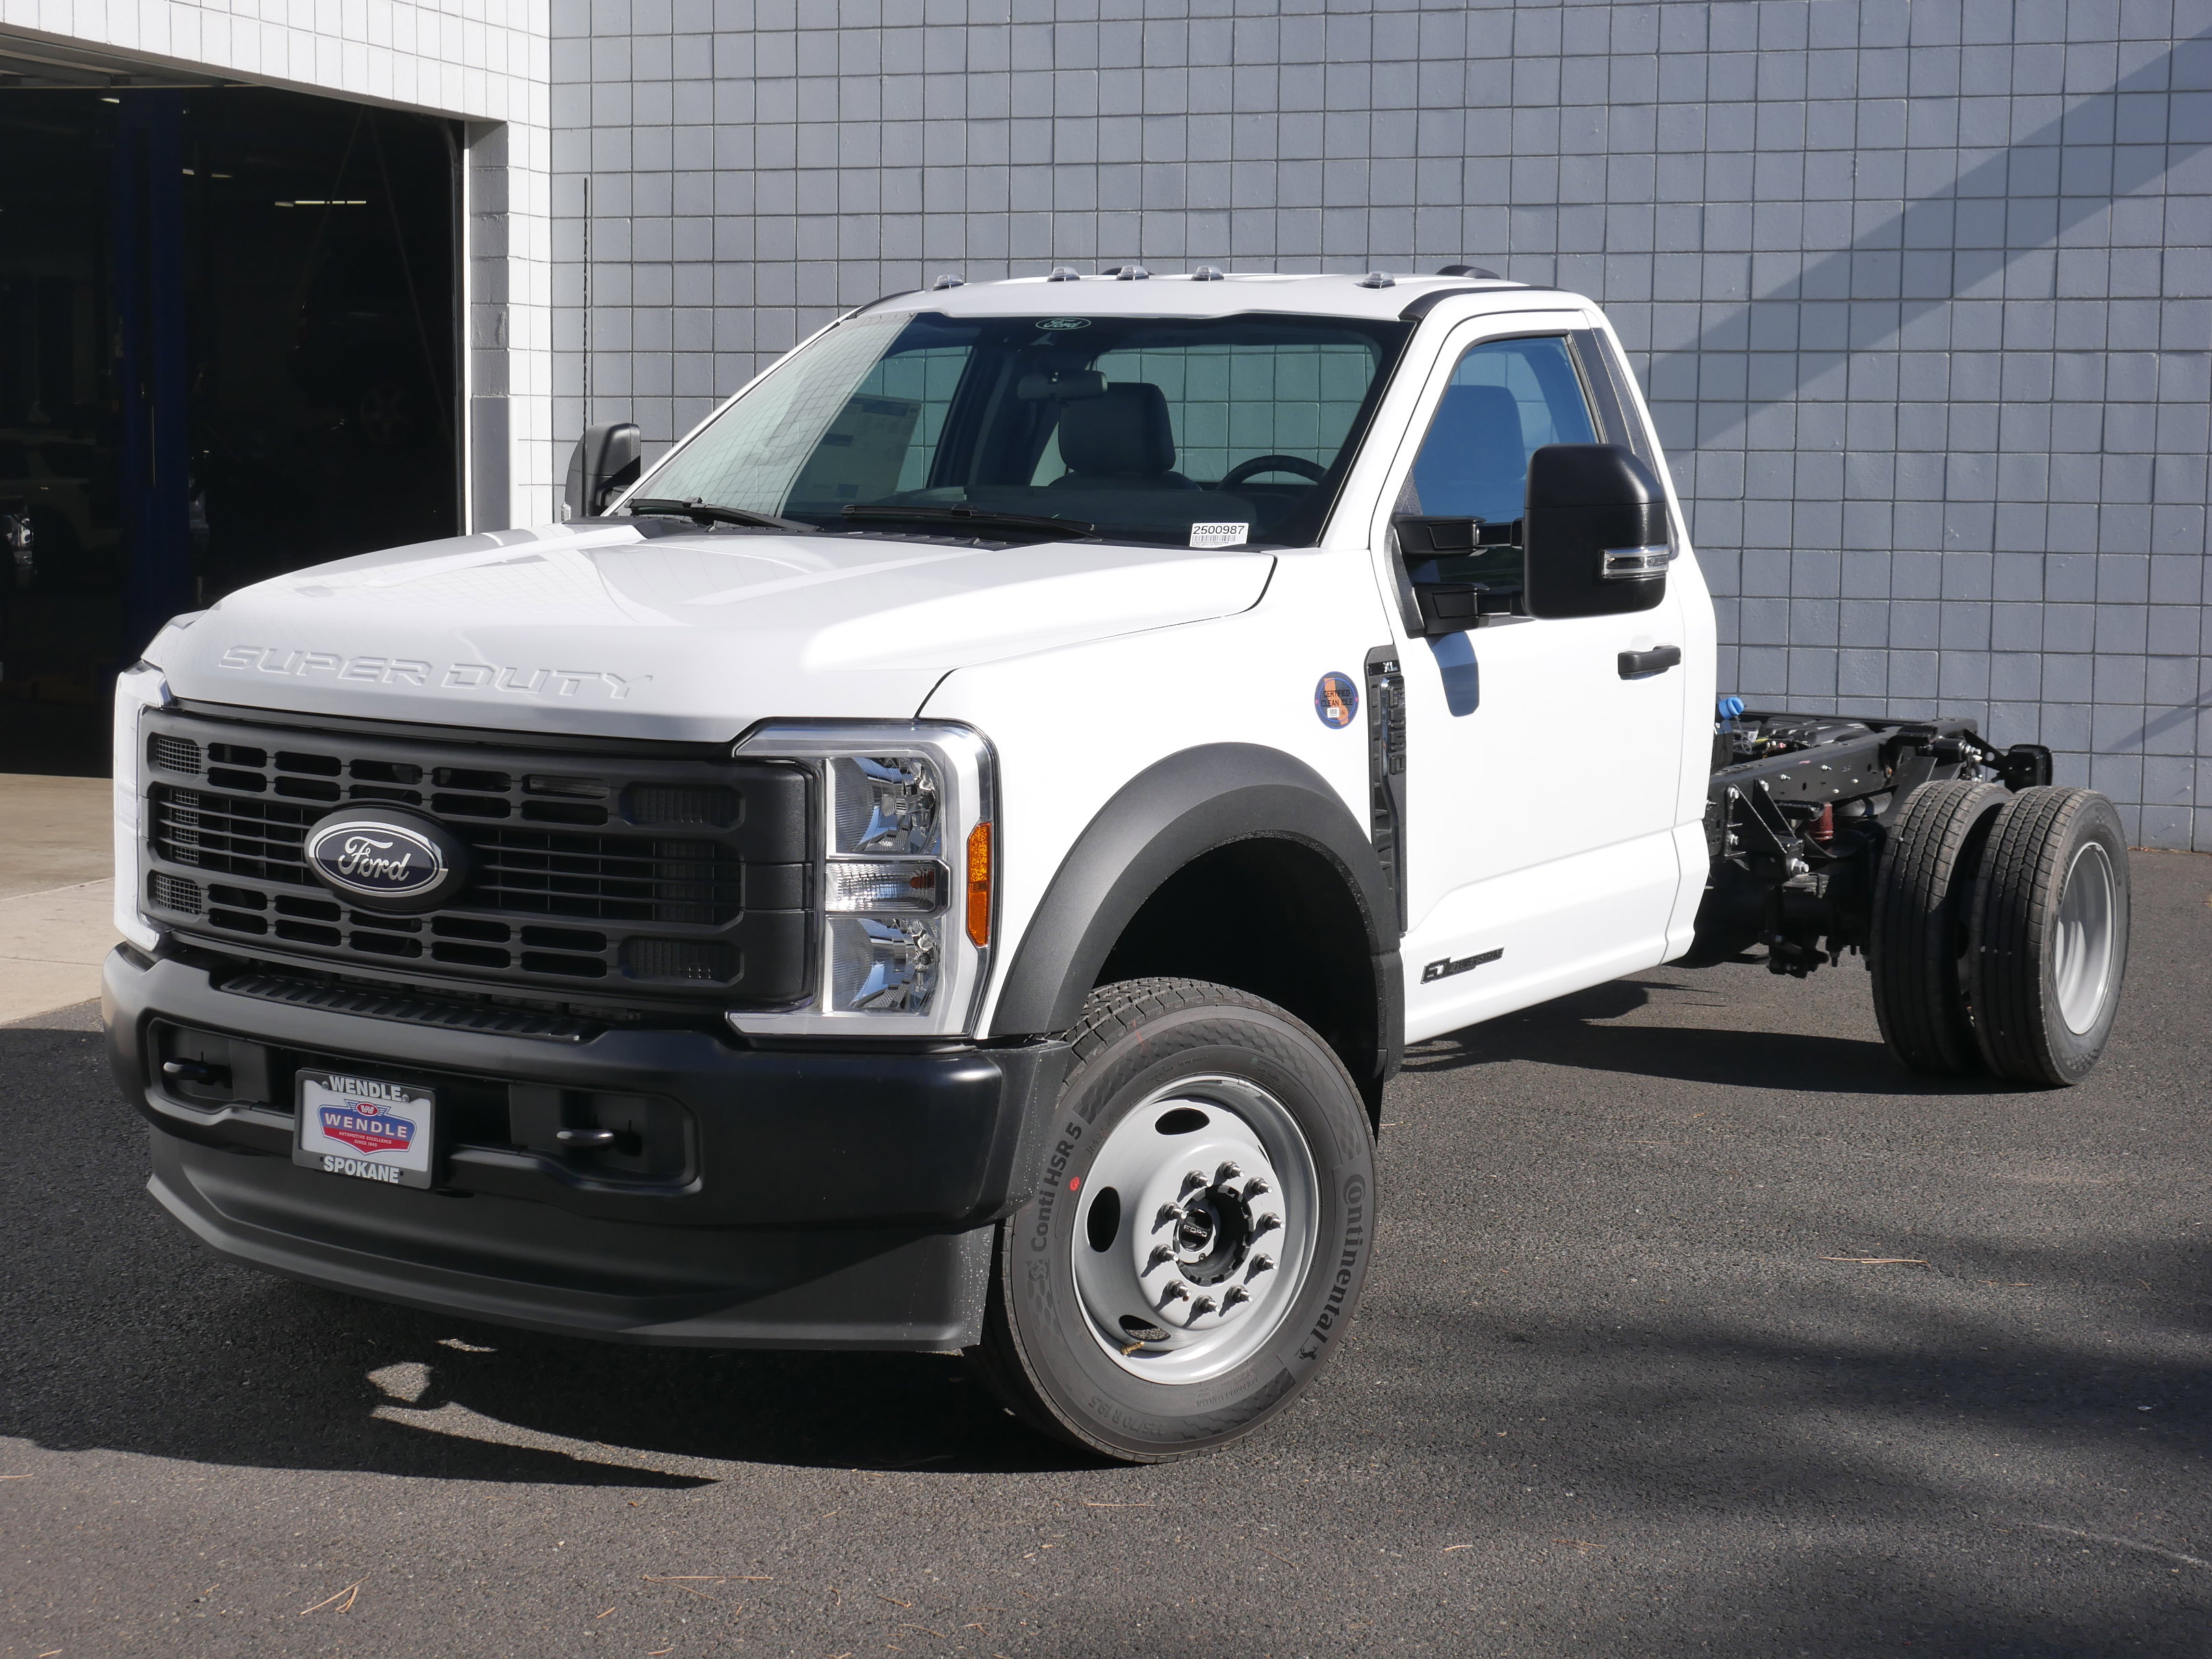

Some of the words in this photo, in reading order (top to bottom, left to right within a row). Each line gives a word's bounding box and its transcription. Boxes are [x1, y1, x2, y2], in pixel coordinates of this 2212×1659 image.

[1043, 319, 1083, 328] Ford
[1193, 525, 1245, 535] 2500987
[218, 645, 434, 686] SUPER
[441, 663, 653, 699] DUTY
[1382, 661, 1398, 673] XL
[1321, 699, 1339, 707] CLEAN
[1323, 689, 1350, 697] CERTIFIED
[337, 836, 411, 882] Ford
[329, 1075, 402, 1103] WENDLE
[324, 1112, 408, 1139] WENDLE
[1065, 1122, 1082, 1141] 5
[339, 1131, 365, 1140] AUTOMOTIVE
[365, 1135, 392, 1144] EXCELLENCE
[323, 1155, 400, 1184] SPOKANE
[1043, 1139, 1075, 1187] HSR
[1031, 1189, 1056, 1252] Conti
[1183, 1224, 1208, 1237] FORD
[1310, 1173, 1367, 1344] Continental
